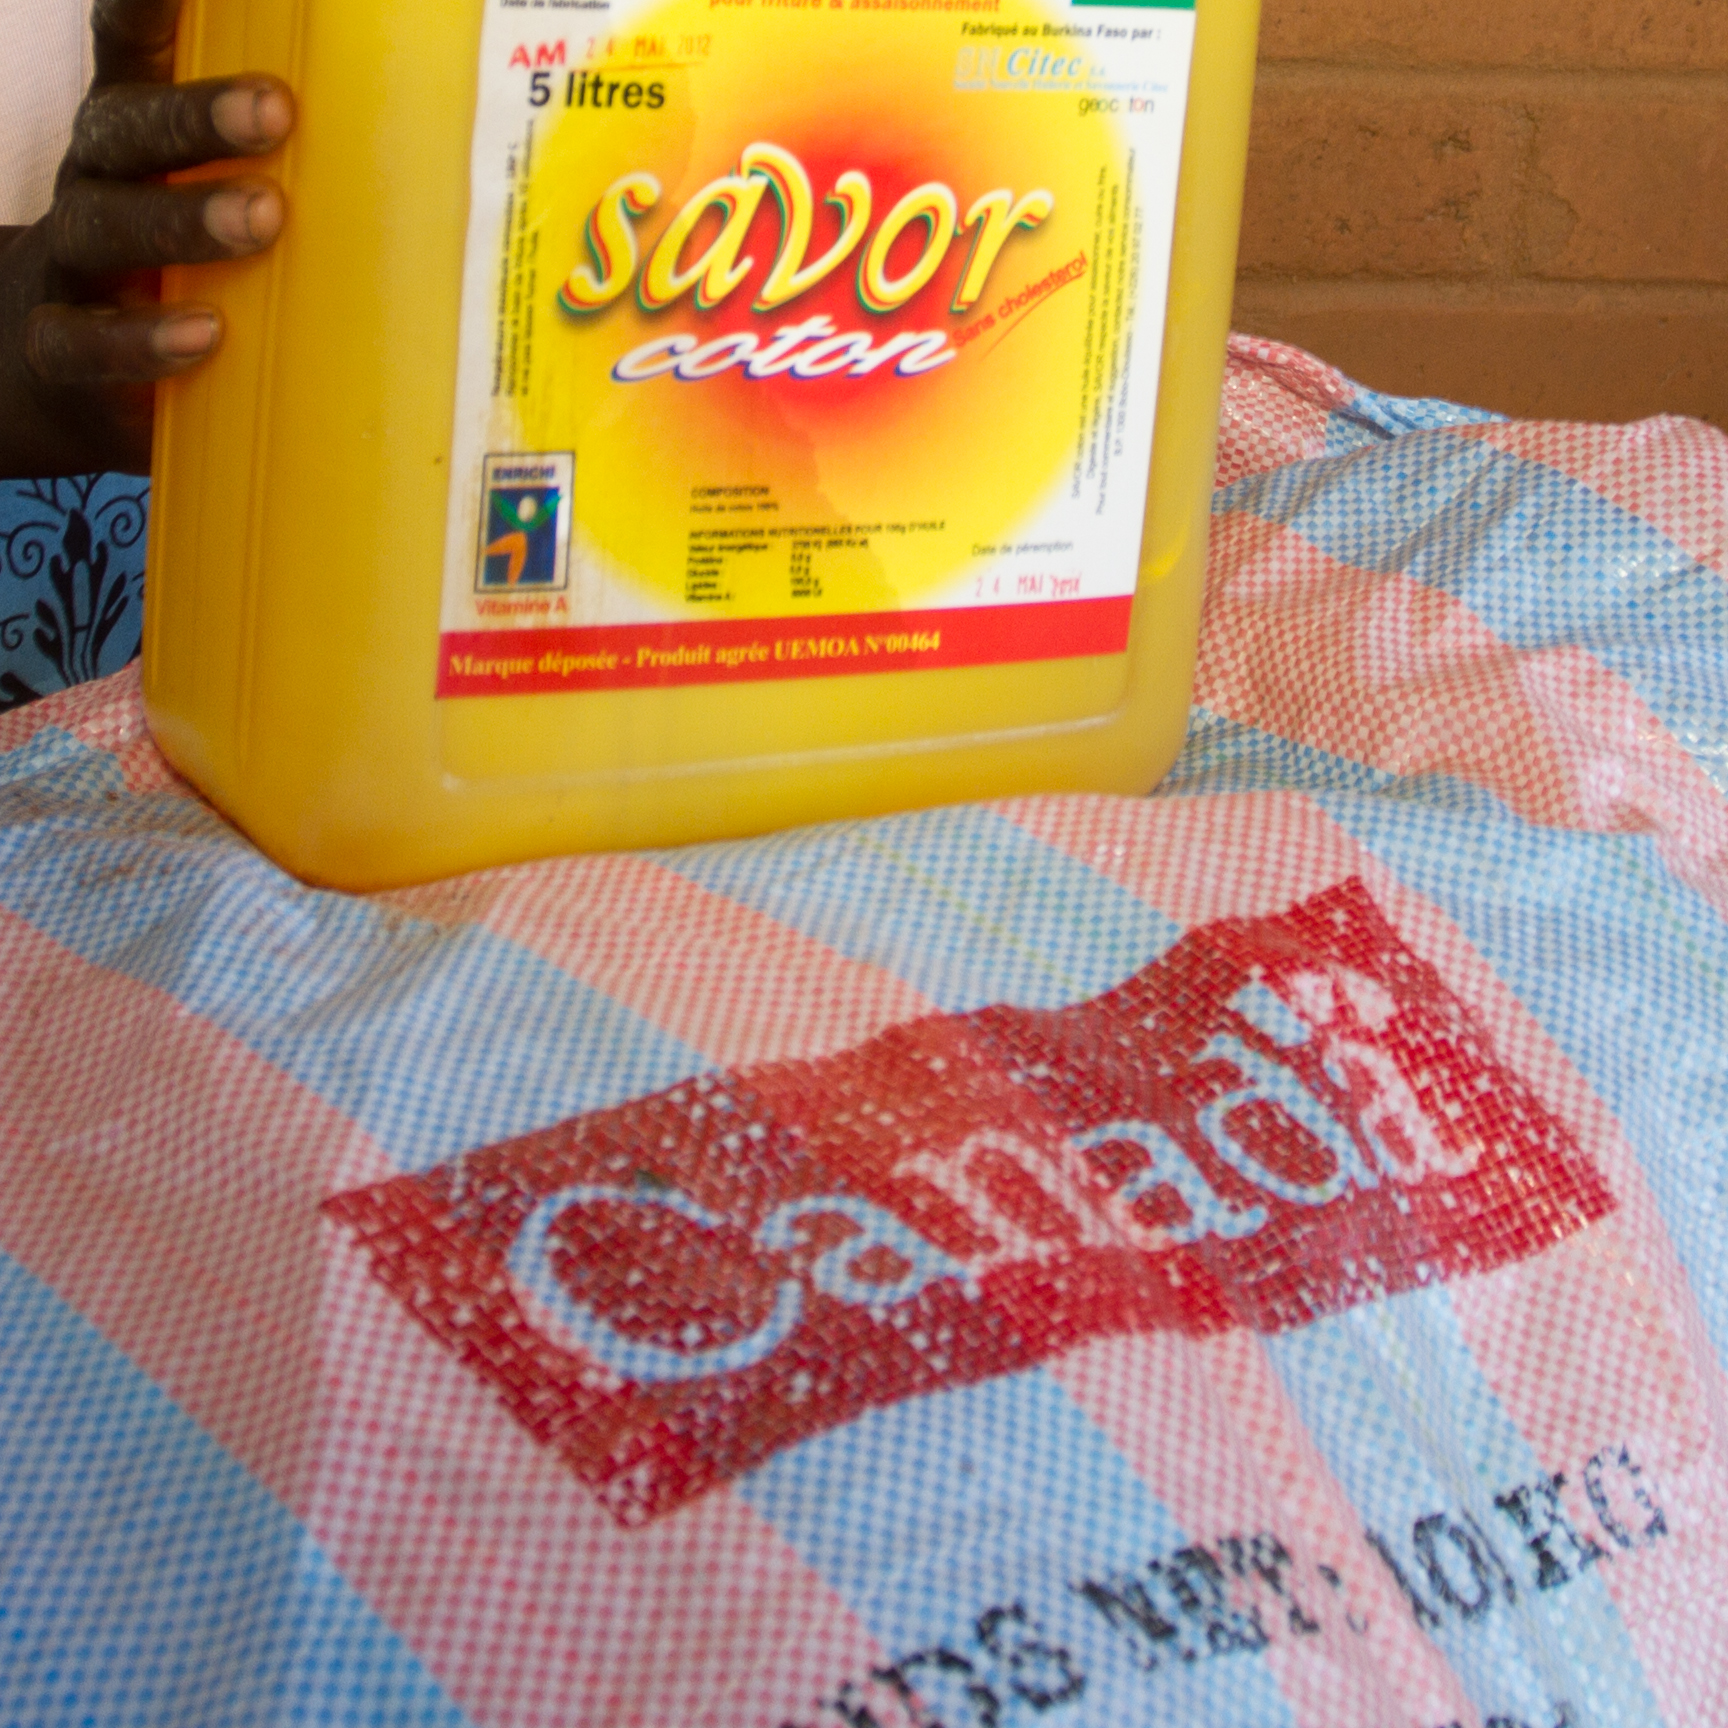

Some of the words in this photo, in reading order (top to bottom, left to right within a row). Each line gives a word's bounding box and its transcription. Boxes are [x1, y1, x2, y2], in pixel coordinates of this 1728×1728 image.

[961, 21, 1018, 39] Fabriqué
[1023, 24, 1038, 36] au
[1042, 22, 1092, 37] Burkina
[1097, 23, 1127, 37] Faso
[1132, 27, 1152, 41] par
[508, 38, 568, 69] AM
[1007, 46, 1083, 76] Citec
[529, 70, 551, 107] 5
[565, 70, 666, 109] litres
[611, 314, 957, 383] coton
[972, 543, 997, 557] Date
[1000, 543, 1013, 555] de
[1016, 541, 1073, 557] péremption
[1016, 572, 1044, 595] MAI
[474, 597, 552, 616] Vitamine
[555, 595, 568, 614] A
[449, 652, 534, 680] Marque
[538, 646, 618, 676] déposée
[637, 645, 710, 669] Produit
[773, 634, 860, 661] UEMOA
[504, 964, 1480, 1385] Canada
